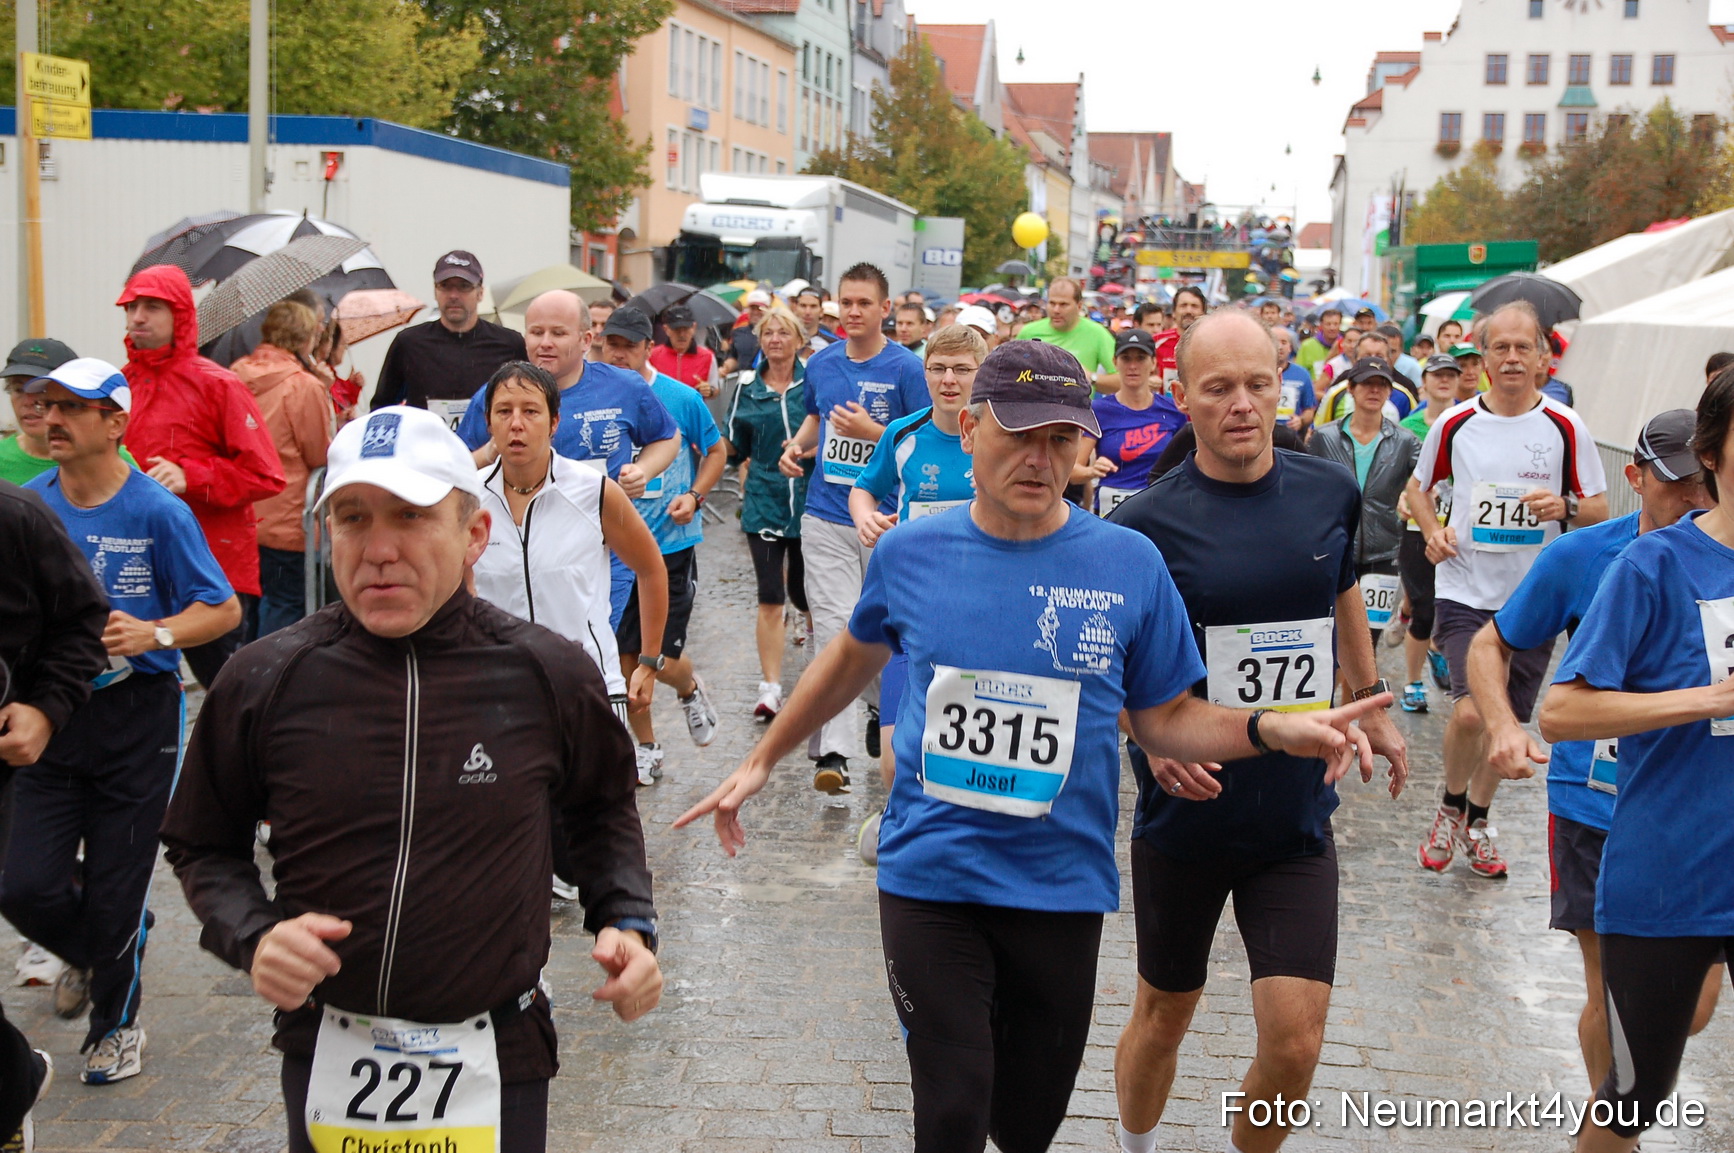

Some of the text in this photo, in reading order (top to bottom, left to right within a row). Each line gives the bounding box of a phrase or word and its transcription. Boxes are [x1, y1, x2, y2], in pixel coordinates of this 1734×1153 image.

[711, 213, 774, 231] BOCK
[1172, 253, 1211, 264] START
[827, 438, 876, 465] 3092
[1489, 531, 1525, 542] Werner
[99, 543, 146, 554] STADTLAUF
[1029, 585, 1124, 606] 12. NEUMARKTER
[1048, 596, 1111, 612] STADTLAUF
[1251, 629, 1302, 644] BOCK
[974, 678, 1032, 698] BOCK
[1238, 654, 1315, 703] 372
[939, 703, 1059, 765] 3315
[458, 771, 498, 785] odlo
[966, 767, 1016, 793] Josef
[346, 1058, 463, 1122] 227
